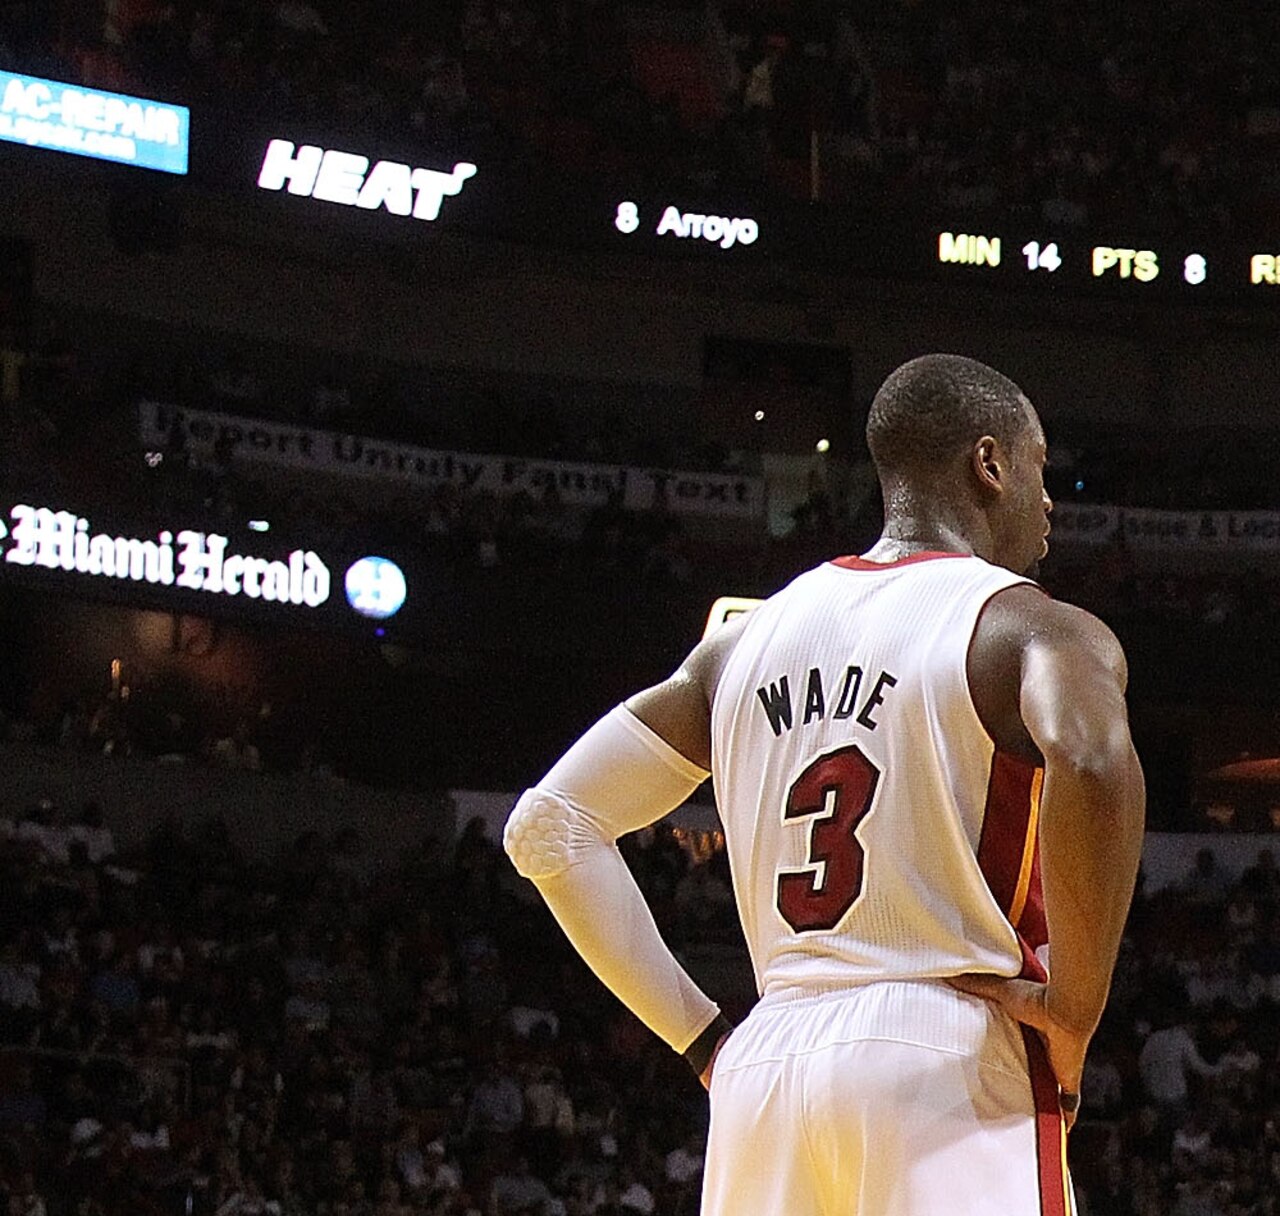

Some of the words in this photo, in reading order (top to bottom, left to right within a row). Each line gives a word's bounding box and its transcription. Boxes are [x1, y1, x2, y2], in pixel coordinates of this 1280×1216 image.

[258, 139, 476, 220] HEAT
[615, 202, 639, 233] 8
[657, 206, 758, 248] Arroyo
[939, 233, 1000, 266] MIN
[1023, 241, 1061, 271] 14
[1093, 247, 1159, 281] PTS
[1184, 254, 1206, 284] 8
[7, 505, 174, 585] Miami
[177, 531, 330, 607] Herald
[757, 665, 898, 737] WADE
[776, 742, 883, 934] 3
